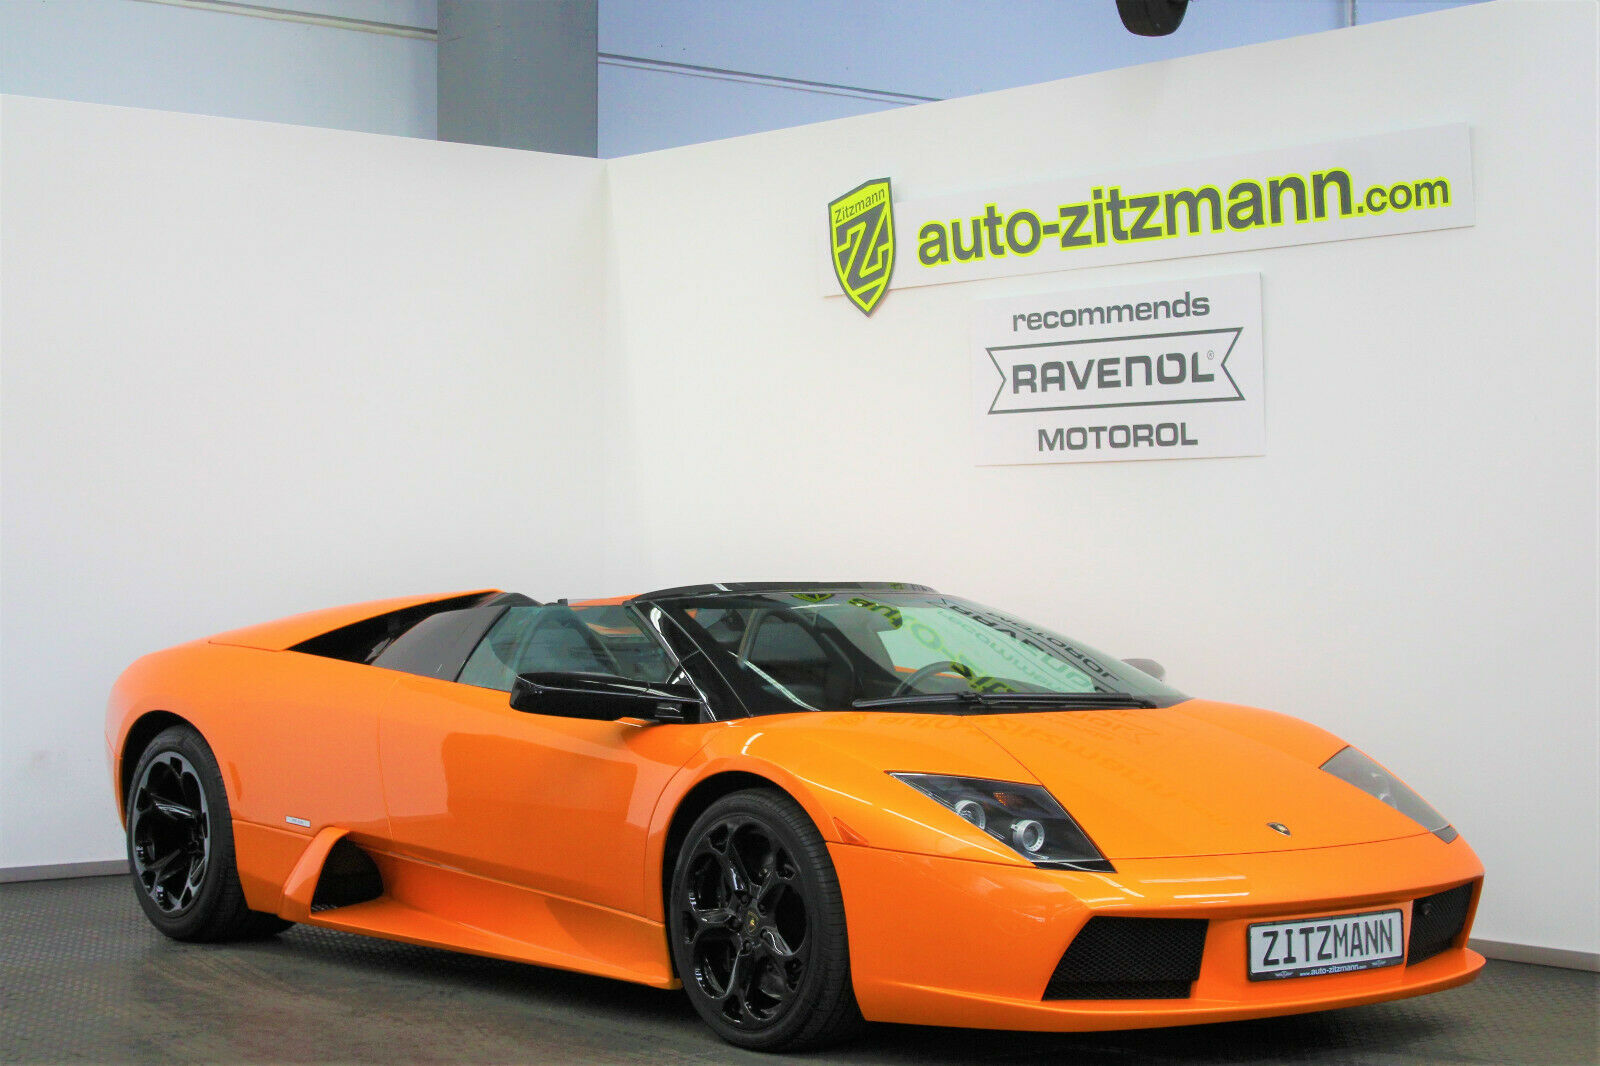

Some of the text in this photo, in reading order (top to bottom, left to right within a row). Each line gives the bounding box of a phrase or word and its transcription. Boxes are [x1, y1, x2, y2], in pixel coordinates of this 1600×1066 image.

[834, 188, 886, 224] Zitzmann
[918, 166, 1451, 269] auto-zitzmann.com
[1012, 291, 1210, 332] recommends
[1038, 422, 1198, 452] MOTOROL
[1263, 918, 1393, 966] ZITZMANN
